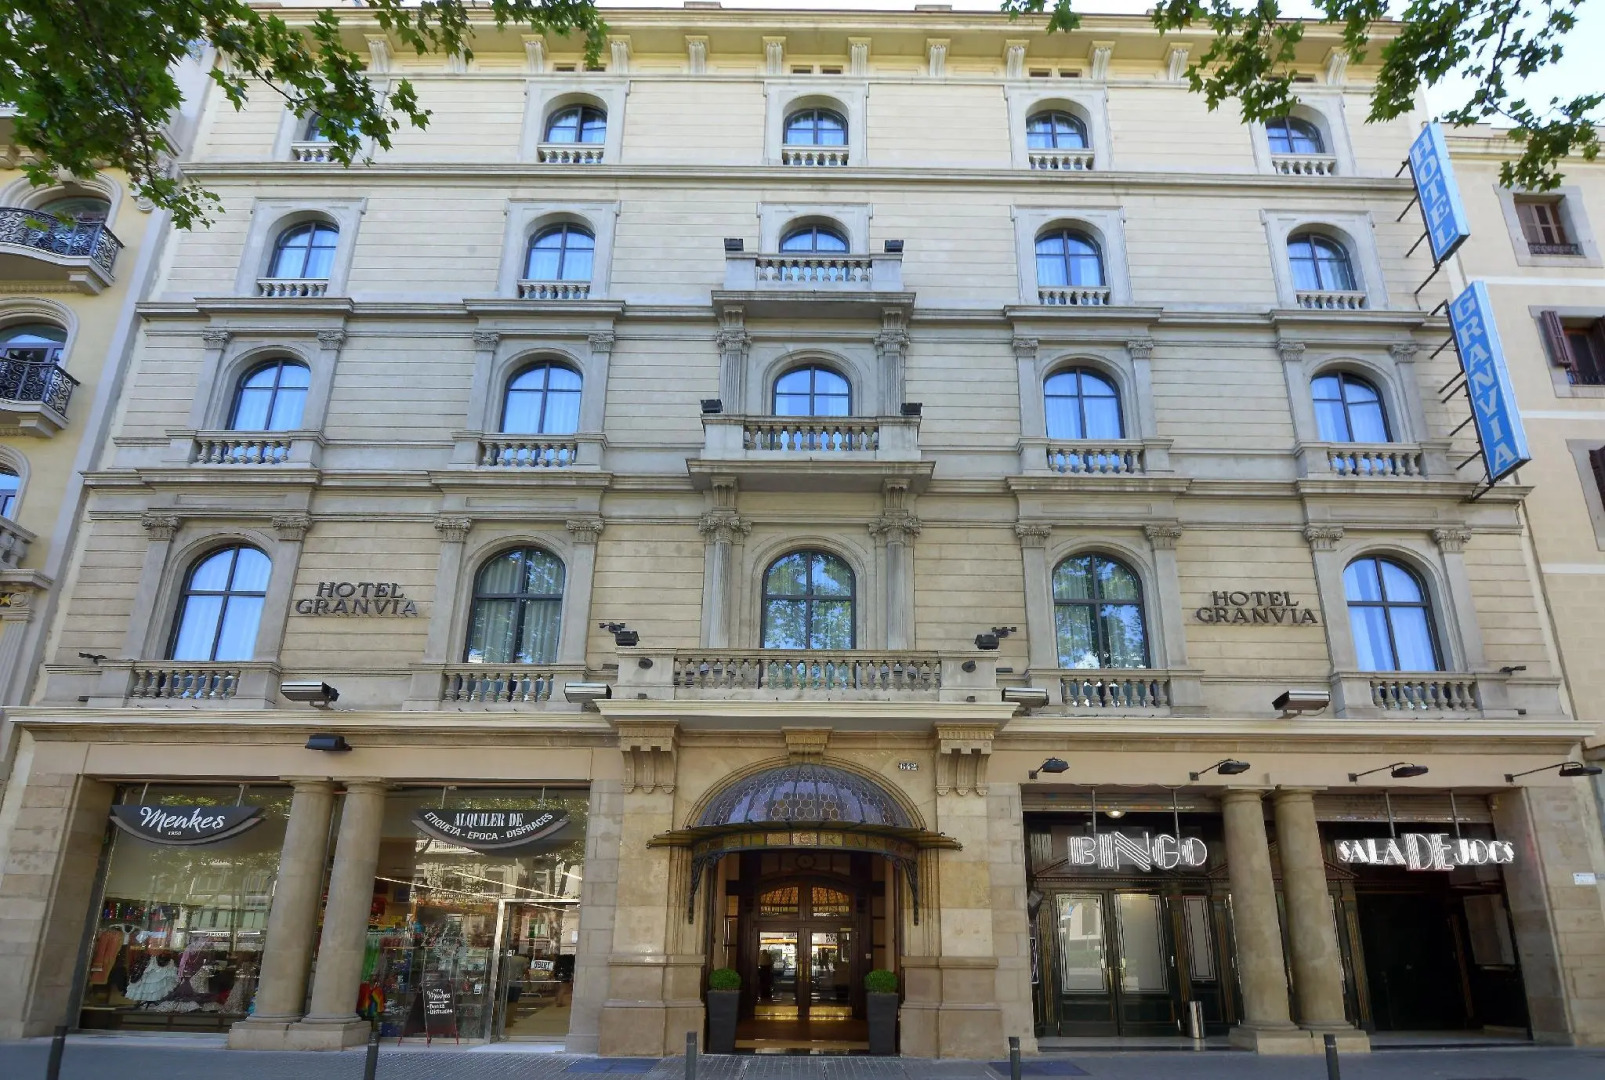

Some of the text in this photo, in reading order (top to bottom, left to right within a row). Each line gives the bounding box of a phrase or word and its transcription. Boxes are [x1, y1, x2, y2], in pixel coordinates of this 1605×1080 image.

[1412, 134, 1457, 252] HOTEL
[1454, 293, 1516, 474] GRANVIA
[316, 582, 404, 598] HOTEL
[1212, 591, 1299, 606] HOTEL
[295, 599, 418, 615] GRANVIA
[1196, 607, 1318, 623] GRANVIA
[140, 807, 225, 832] Menkes
[424, 812, 461, 836] ETIQUETA
[467, 831, 498, 840] EPOCA
[506, 812, 553, 839] DISFRACES
[453, 813, 524, 828] ALQUILER DE
[1069, 831, 1208, 871] BINGO
[1338, 833, 1515, 870] SALA DE JOCS
